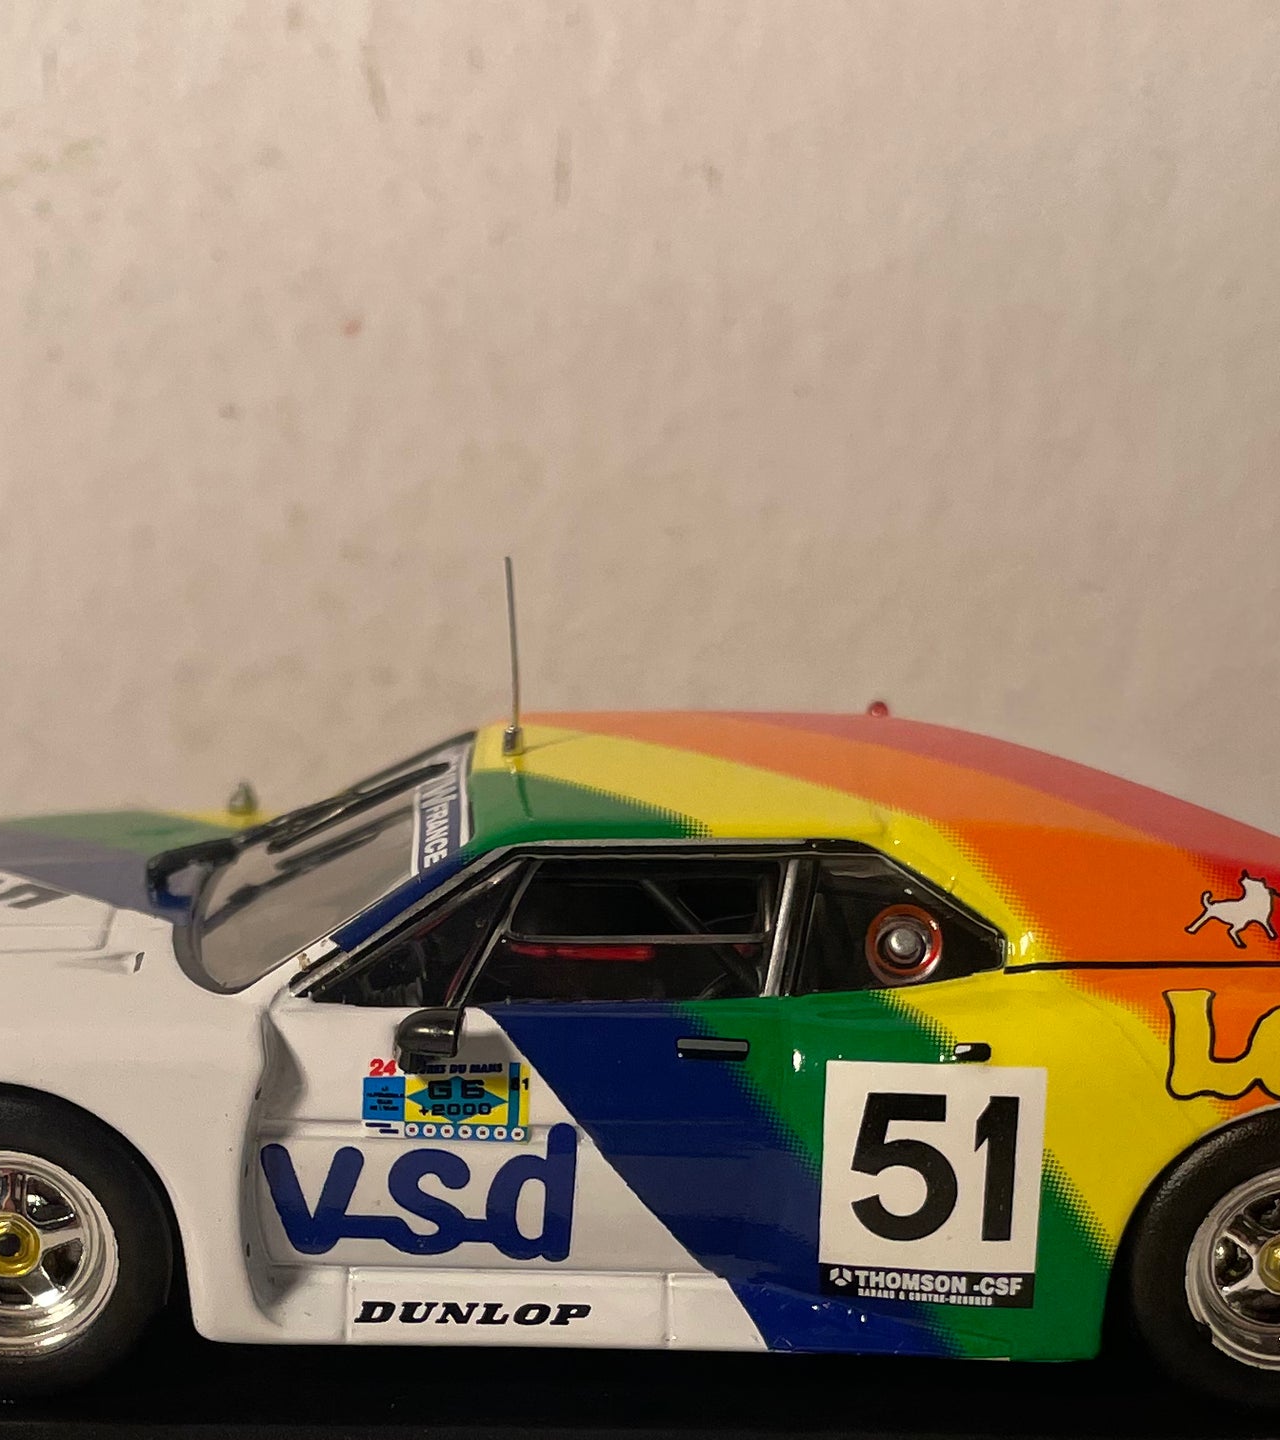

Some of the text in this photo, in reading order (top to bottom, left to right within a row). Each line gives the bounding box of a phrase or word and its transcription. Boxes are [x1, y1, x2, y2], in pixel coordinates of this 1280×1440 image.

[423, 801, 449, 868] FRANCE
[369, 1058, 397, 1076] 24
[419, 1103, 492, 1116] +2000
[850, 1094, 1017, 1242] 51
[854, 1270, 967, 1294] THOMSON
[354, 1301, 592, 1325] DUNLOP
